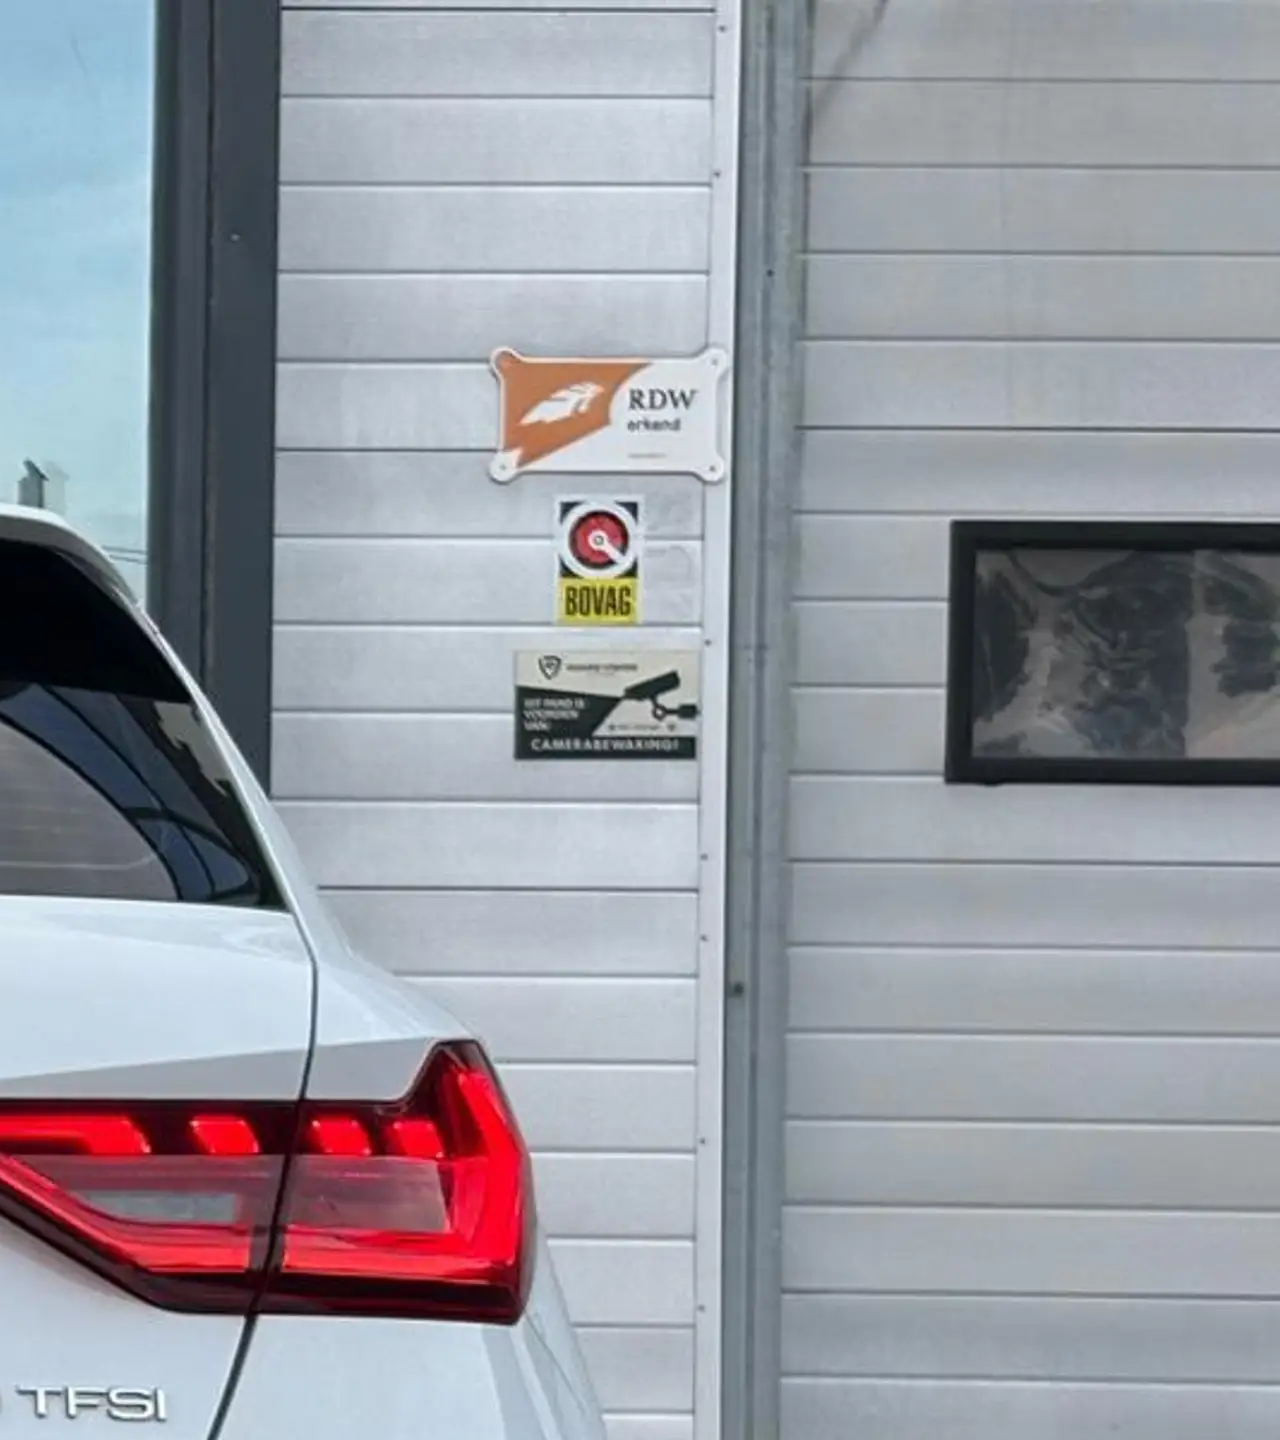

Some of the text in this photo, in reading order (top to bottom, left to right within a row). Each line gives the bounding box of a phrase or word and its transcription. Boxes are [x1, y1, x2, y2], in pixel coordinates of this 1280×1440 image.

[627, 388, 697, 411] RDW
[564, 585, 632, 617] BOVAG
[14, 1384, 168, 1422] TFSI
